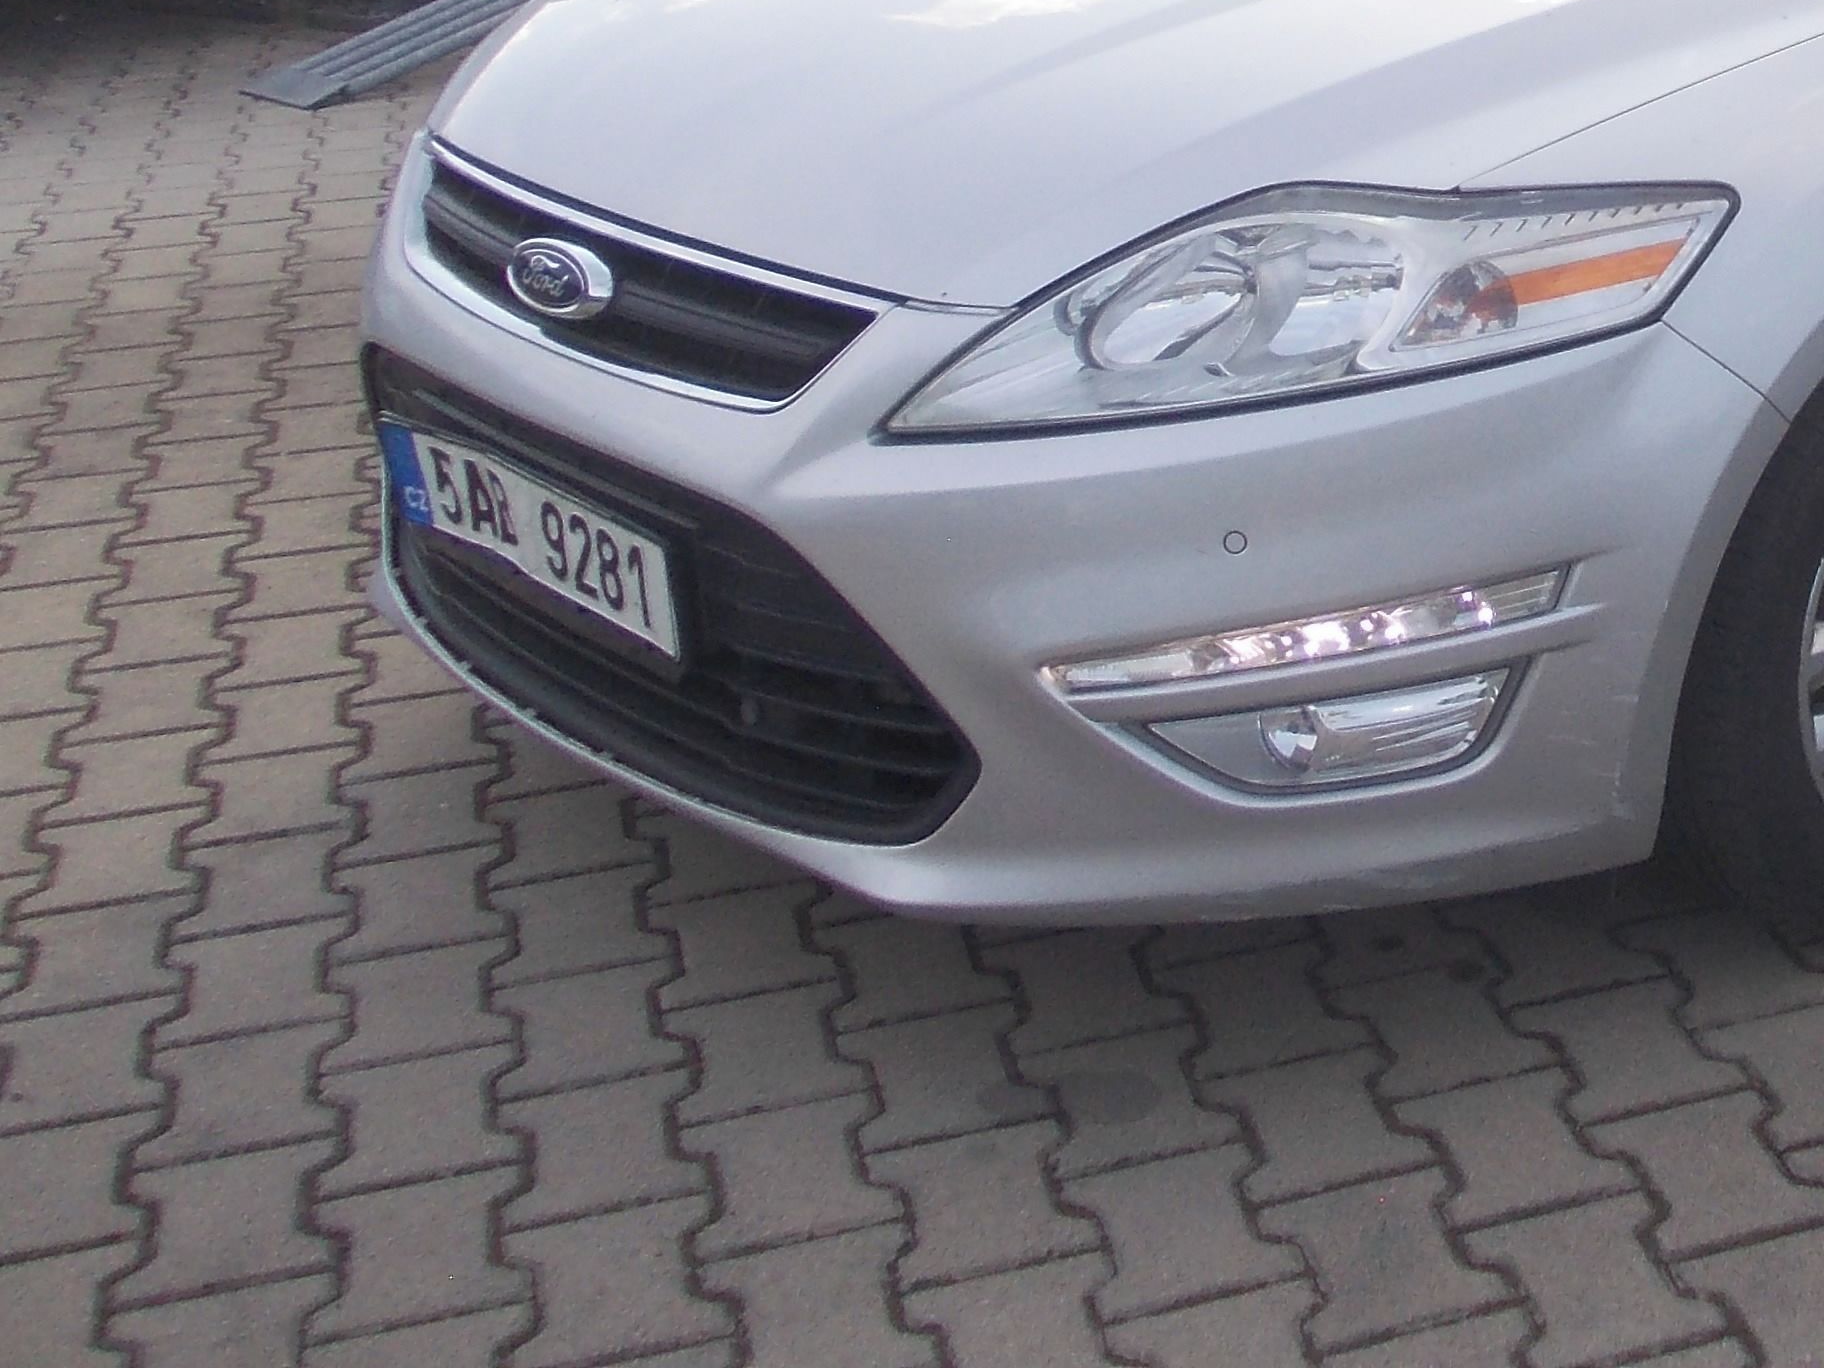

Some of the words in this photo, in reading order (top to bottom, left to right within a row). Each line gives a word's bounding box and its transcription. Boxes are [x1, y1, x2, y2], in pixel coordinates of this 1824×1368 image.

[522, 254, 569, 298] Ford
[403, 485, 429, 512] CZ
[540, 499, 653, 630] 9281
